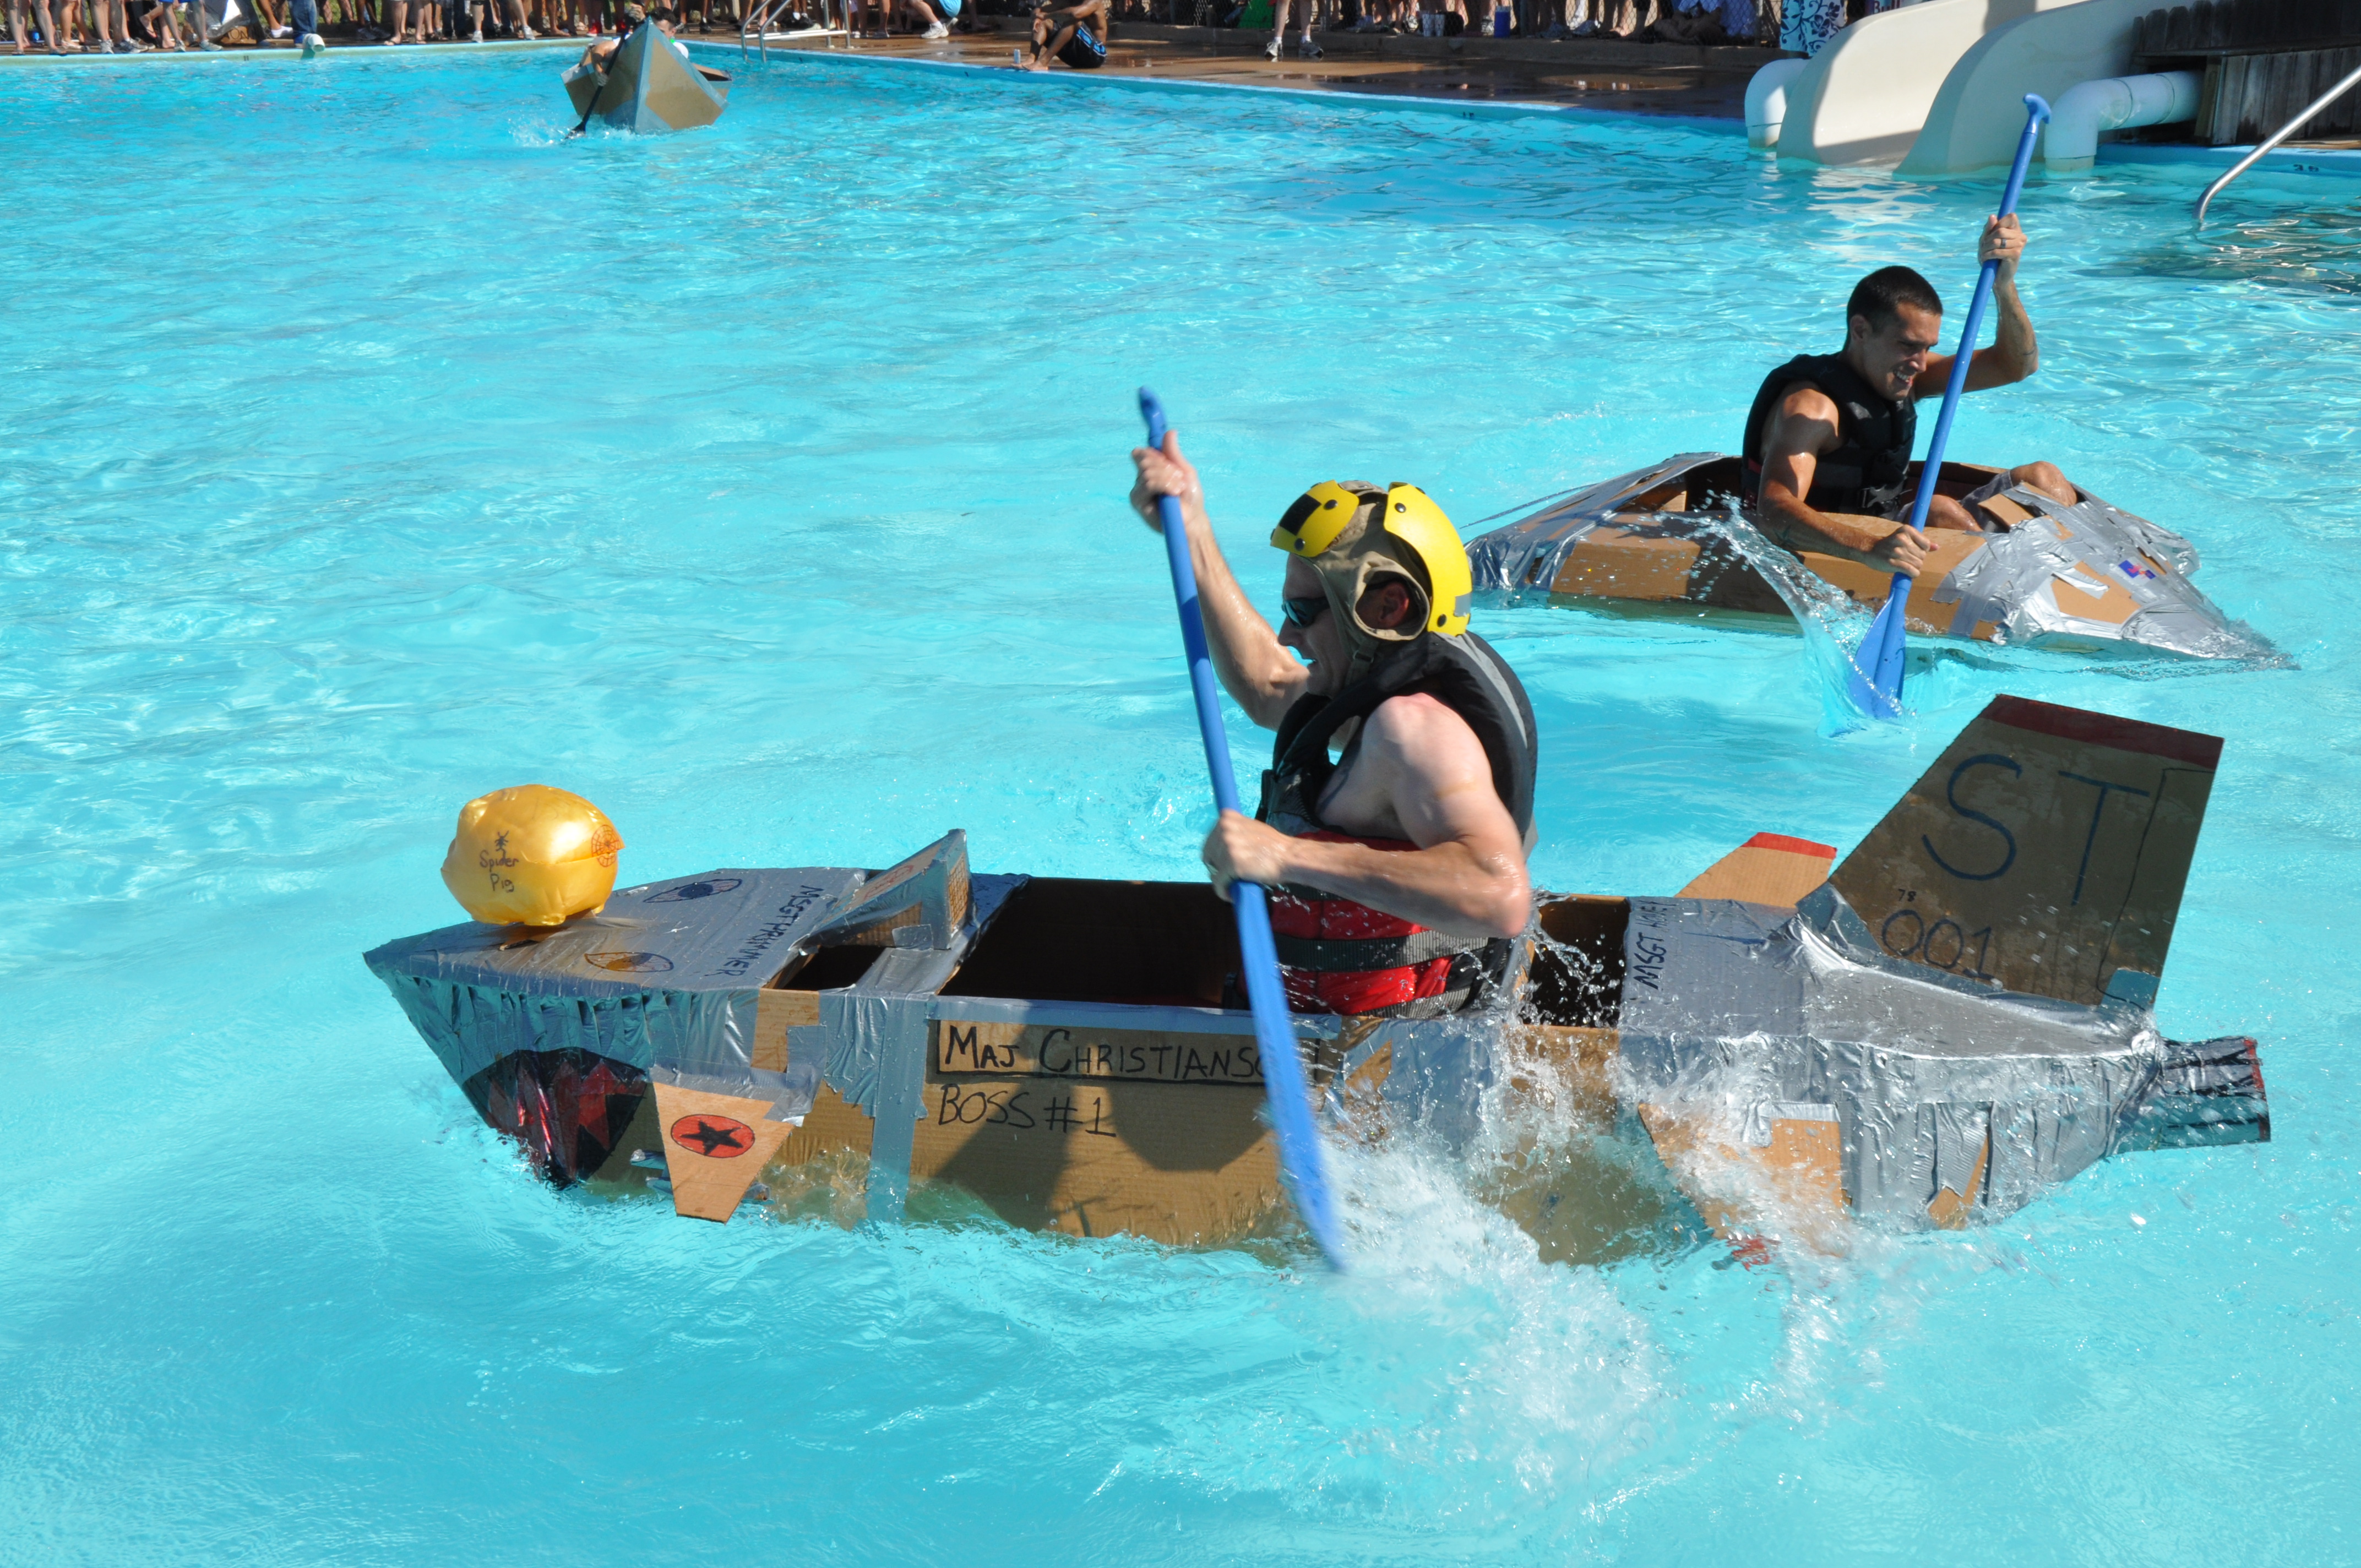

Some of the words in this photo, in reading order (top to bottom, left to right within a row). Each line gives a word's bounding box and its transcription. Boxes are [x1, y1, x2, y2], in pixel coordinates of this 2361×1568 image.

[1921, 753, 2150, 906] ST
[479, 849, 519, 872] Spider
[490, 873, 515, 893] Pig
[775, 884, 825, 923] MSGT
[1897, 888, 1917, 903] 78
[1633, 932, 1668, 990] MSGT
[1881, 908, 1996, 981] 001
[938, 1084, 1036, 1129] BOSS
[1043, 1096, 1117, 1138] #1
